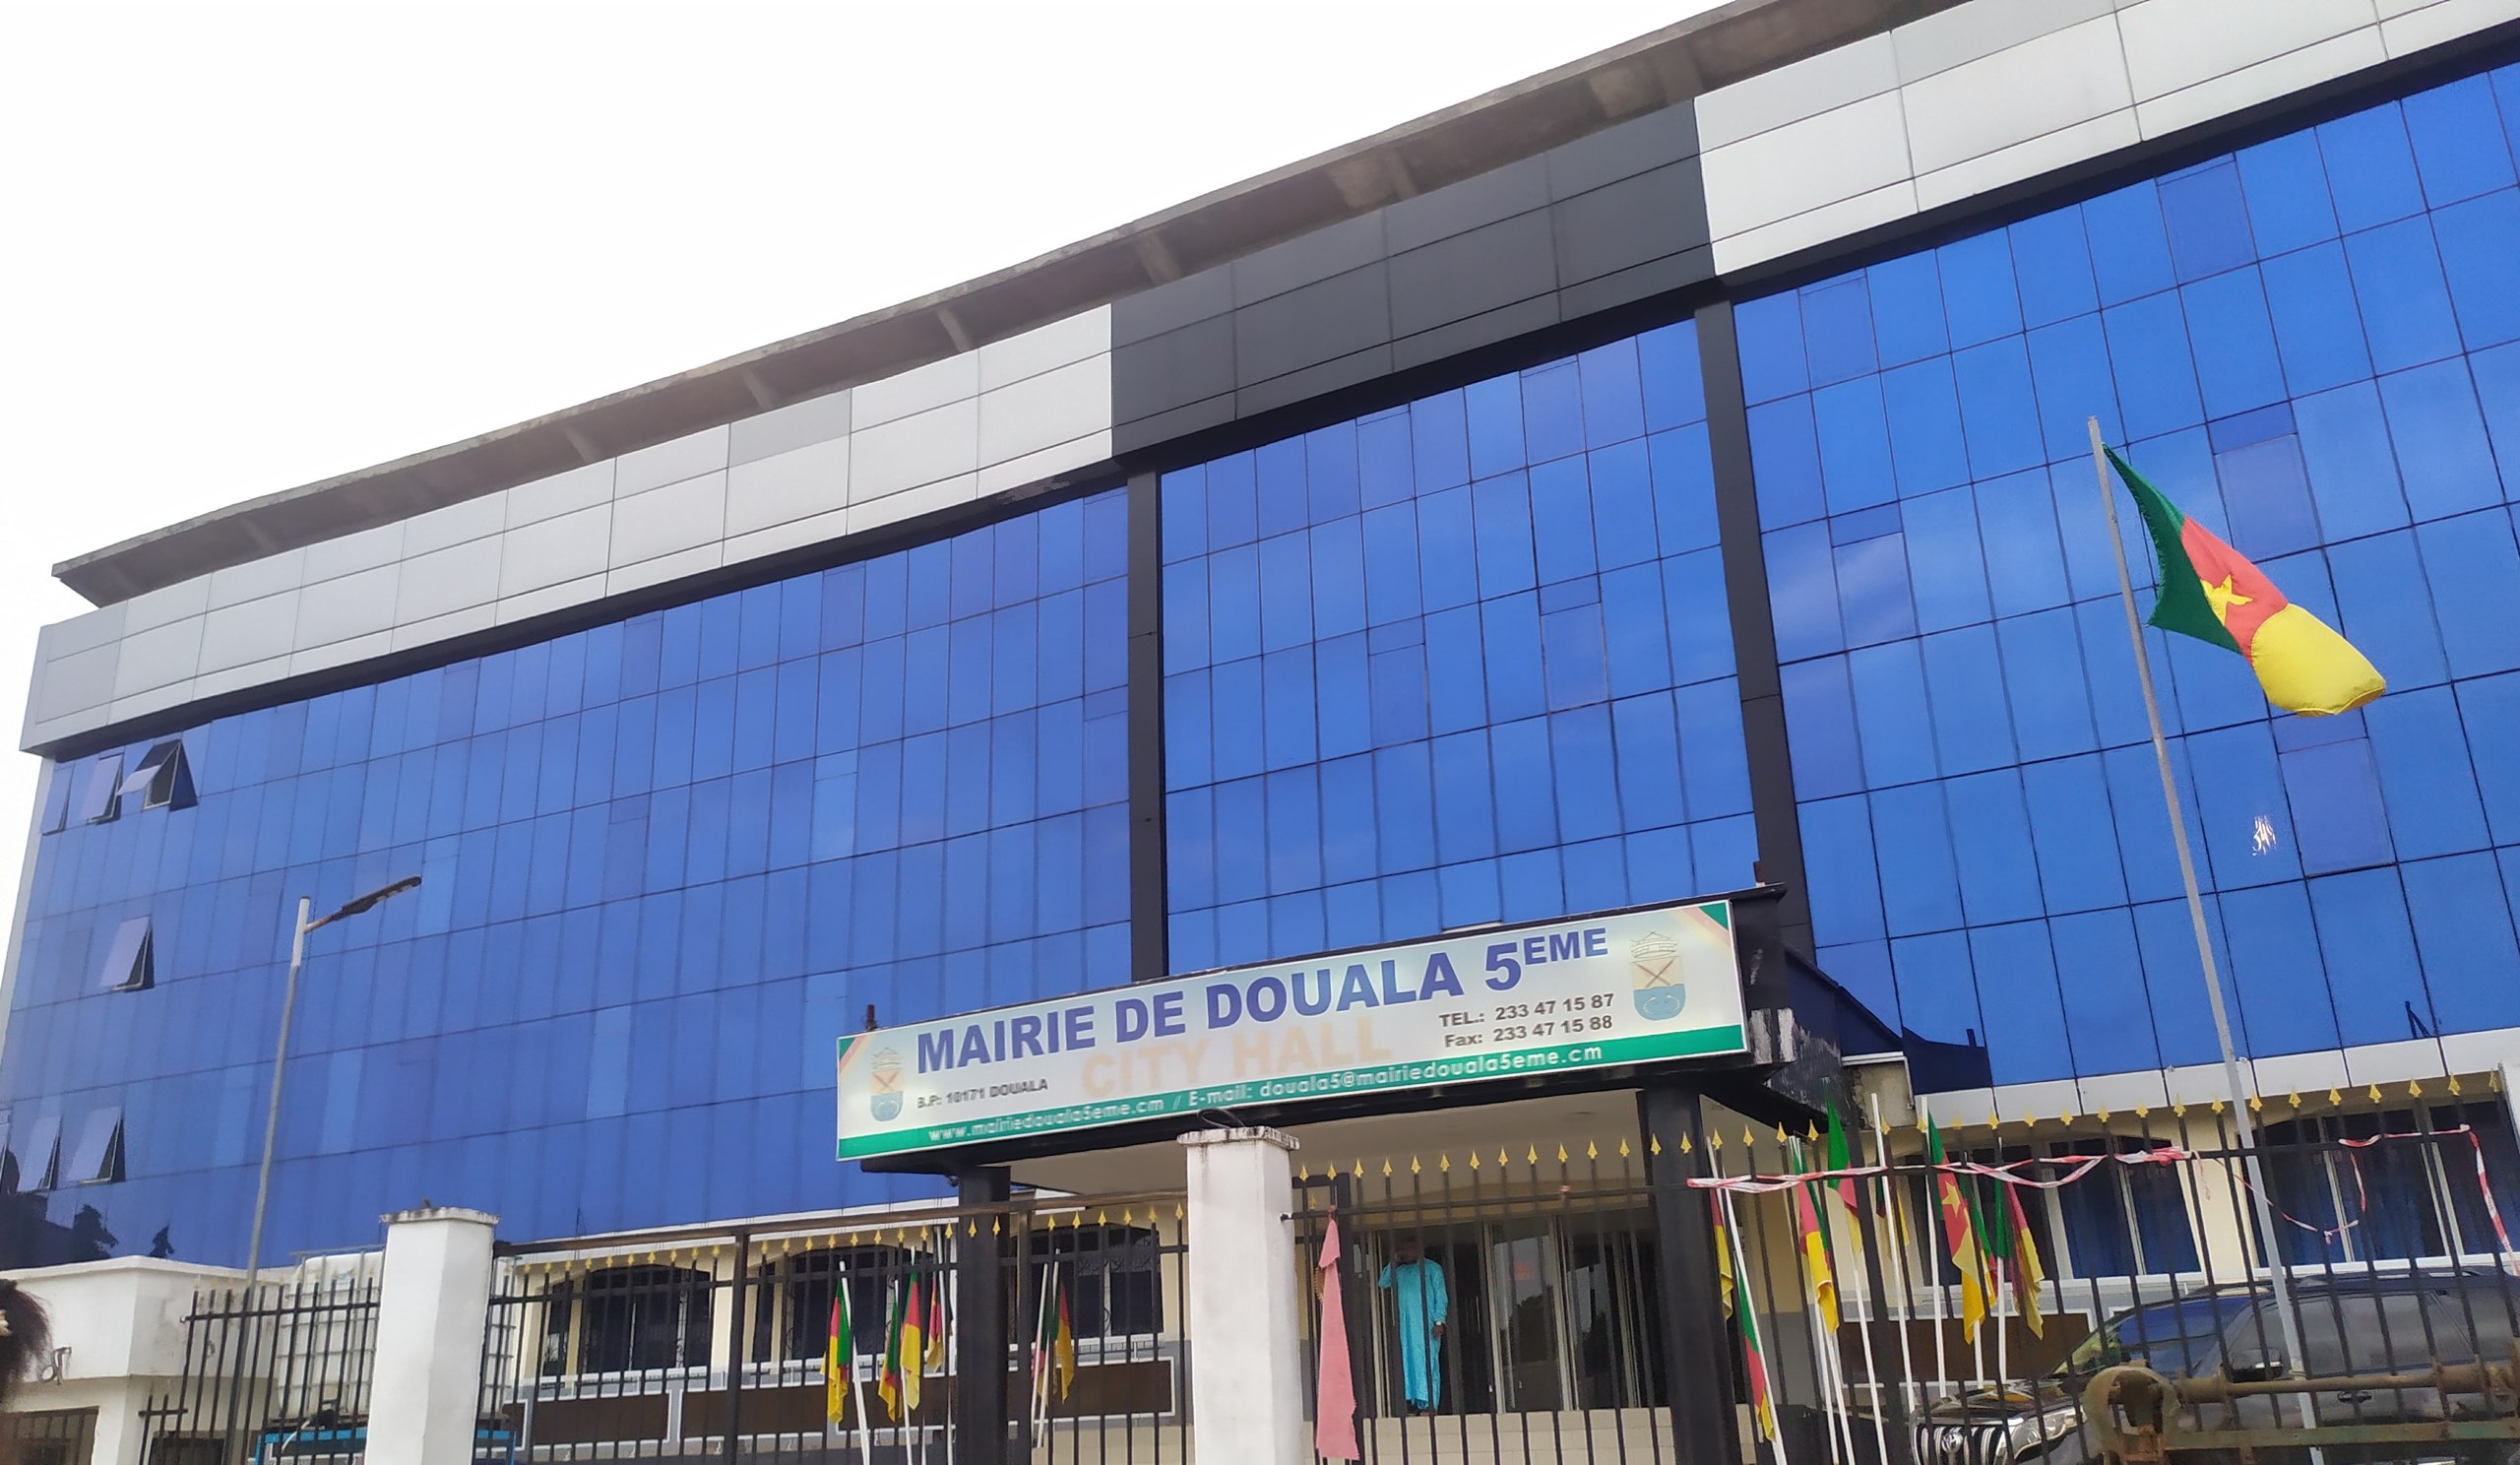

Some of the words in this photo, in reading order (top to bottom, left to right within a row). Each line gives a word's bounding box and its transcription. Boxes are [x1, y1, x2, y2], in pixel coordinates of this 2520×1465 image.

[917, 1005, 1096, 1074] MAIRIE
[1115, 990, 1186, 1043] DE
[1206, 951, 1465, 1030] DOUALA
[1445, 1033, 1483, 1049] Fax:
[1493, 1026, 1528, 1042] 233
[1533, 1022, 1555, 1037] 47
[1562, 1019, 1584, 1034] 15
[1590, 1015, 1612, 1031] 88
[1495, 1003, 1529, 1020] 233
[1535, 999, 1556, 1015] 47
[1563, 997, 1586, 1012] 15
[1591, 993, 1614, 1009] 87
[1084, 1039, 1210, 1098] CITY
[1234, 1016, 1392, 1078] HALL
[928, 1099, 1164, 1142] www.mairiedouala5eme.cm
[1188, 1083, 1252, 1106] E-mail:
[1260, 1045, 1603, 1098] douala5@mairiedouala5eme.cm
[946, 1088, 986, 1104] 10171
[989, 1079, 1048, 1098] DOUALA
